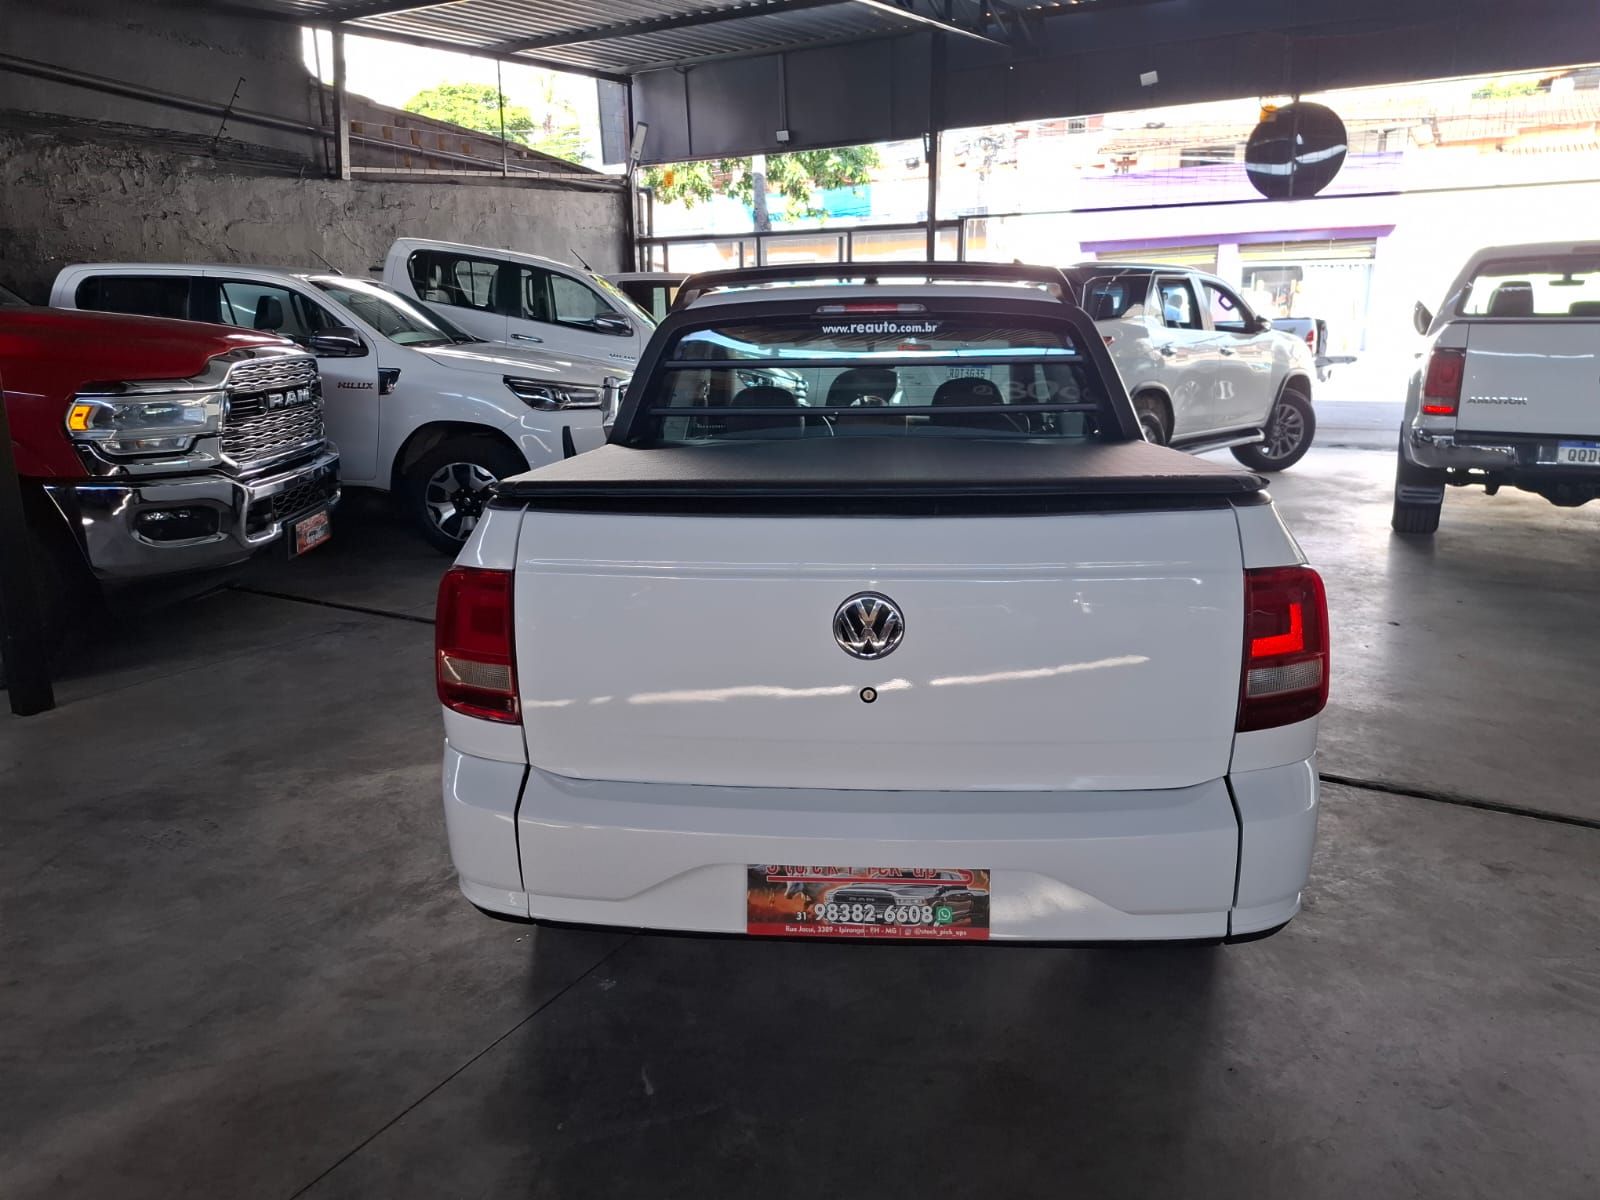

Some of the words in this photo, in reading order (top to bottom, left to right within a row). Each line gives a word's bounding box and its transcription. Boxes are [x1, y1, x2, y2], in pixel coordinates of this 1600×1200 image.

[821, 321, 938, 334] www.reauto.com.br
[337, 381, 375, 390] HILUX
[268, 388, 310, 409] RAM
[1567, 448, 1600, 463] QQD
[796, 911, 807, 921] 31
[814, 903, 934, 924] 98382-6608
